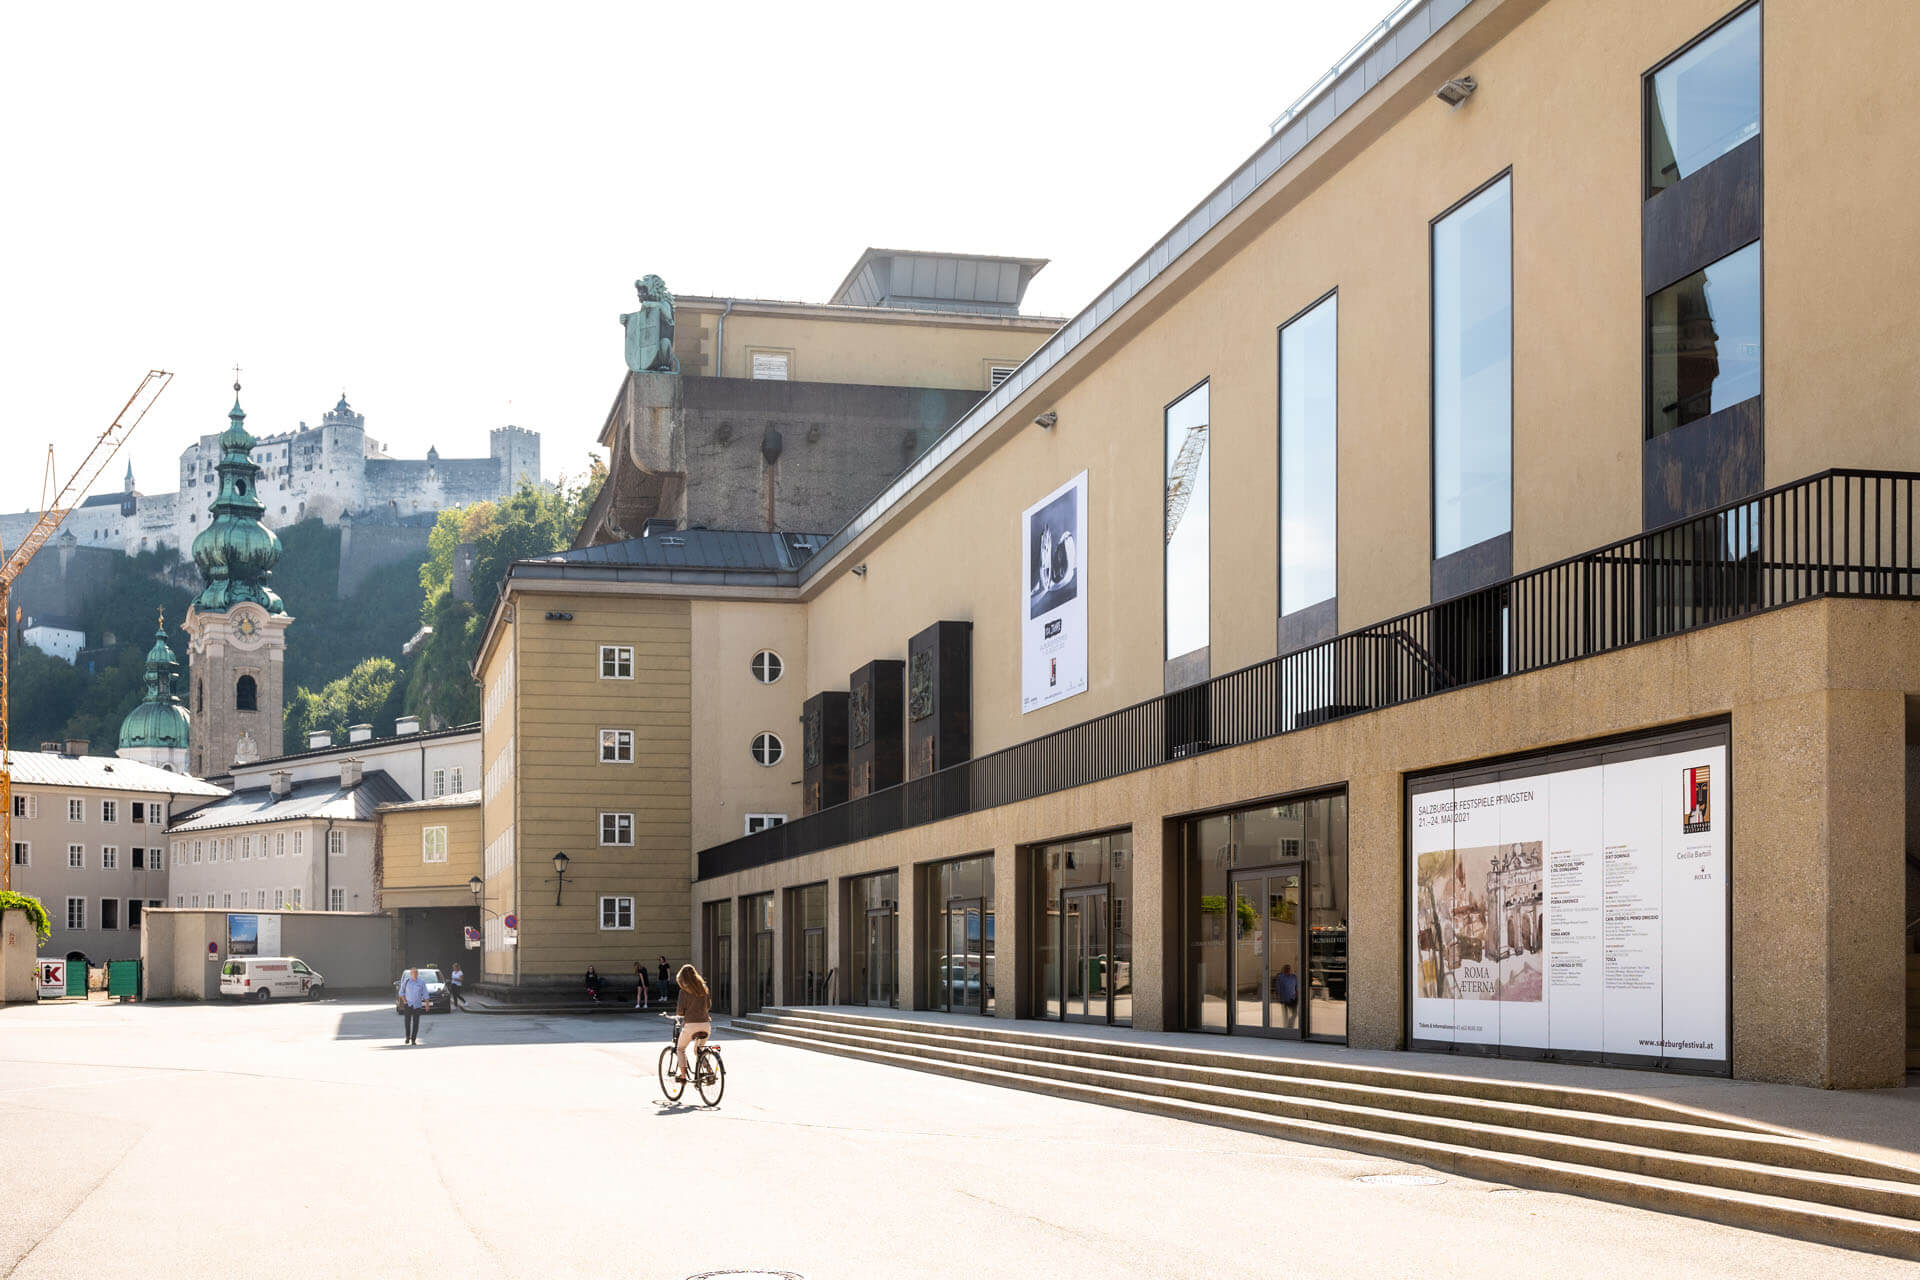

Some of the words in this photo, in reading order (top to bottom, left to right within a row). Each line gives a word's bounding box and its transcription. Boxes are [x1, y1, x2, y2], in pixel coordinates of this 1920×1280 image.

[1418, 802, 1458, 815] SALZBURGER
[1459, 796, 1495, 810] FESTSPIELE
[1496, 791, 1534, 805] PFINGSTEN
[1440, 814, 1454, 824] MAI
[1455, 813, 1470, 822] 2021
[1676, 851, 1694, 860] Cecilia
[1464, 966, 1490, 978] ROMA
[1639, 1039, 1714, 1050] www.salzburgfestival.at
